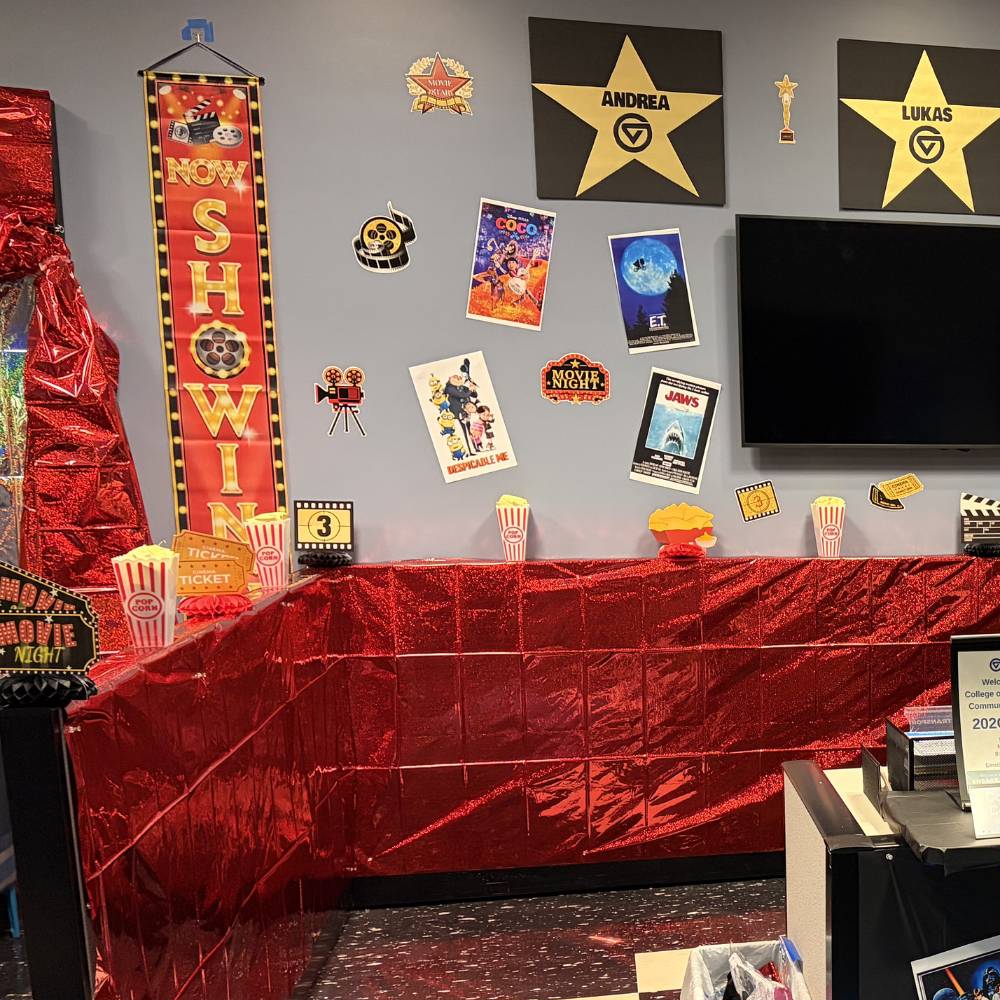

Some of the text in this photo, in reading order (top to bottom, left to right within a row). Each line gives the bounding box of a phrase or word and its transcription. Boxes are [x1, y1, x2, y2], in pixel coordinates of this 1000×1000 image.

[601, 90, 670, 112] ANDREA
[902, 104, 953, 123] LUKAS
[166, 157, 248, 187] NOW
[495, 217, 538, 236] COCO
[551, 369, 600, 381] MOVIE
[551, 379, 601, 390] NIGHT
[664, 390, 700, 408] JAWS
[447, 451, 510, 475] DESPICABLE ME
[317, 515, 332, 537] 3
[180, 574, 231, 585] TICKET
[0, 619, 77, 647] MOVIE
[14, 646, 66, 663] NIGHT
[964, 690, 994, 699] College
